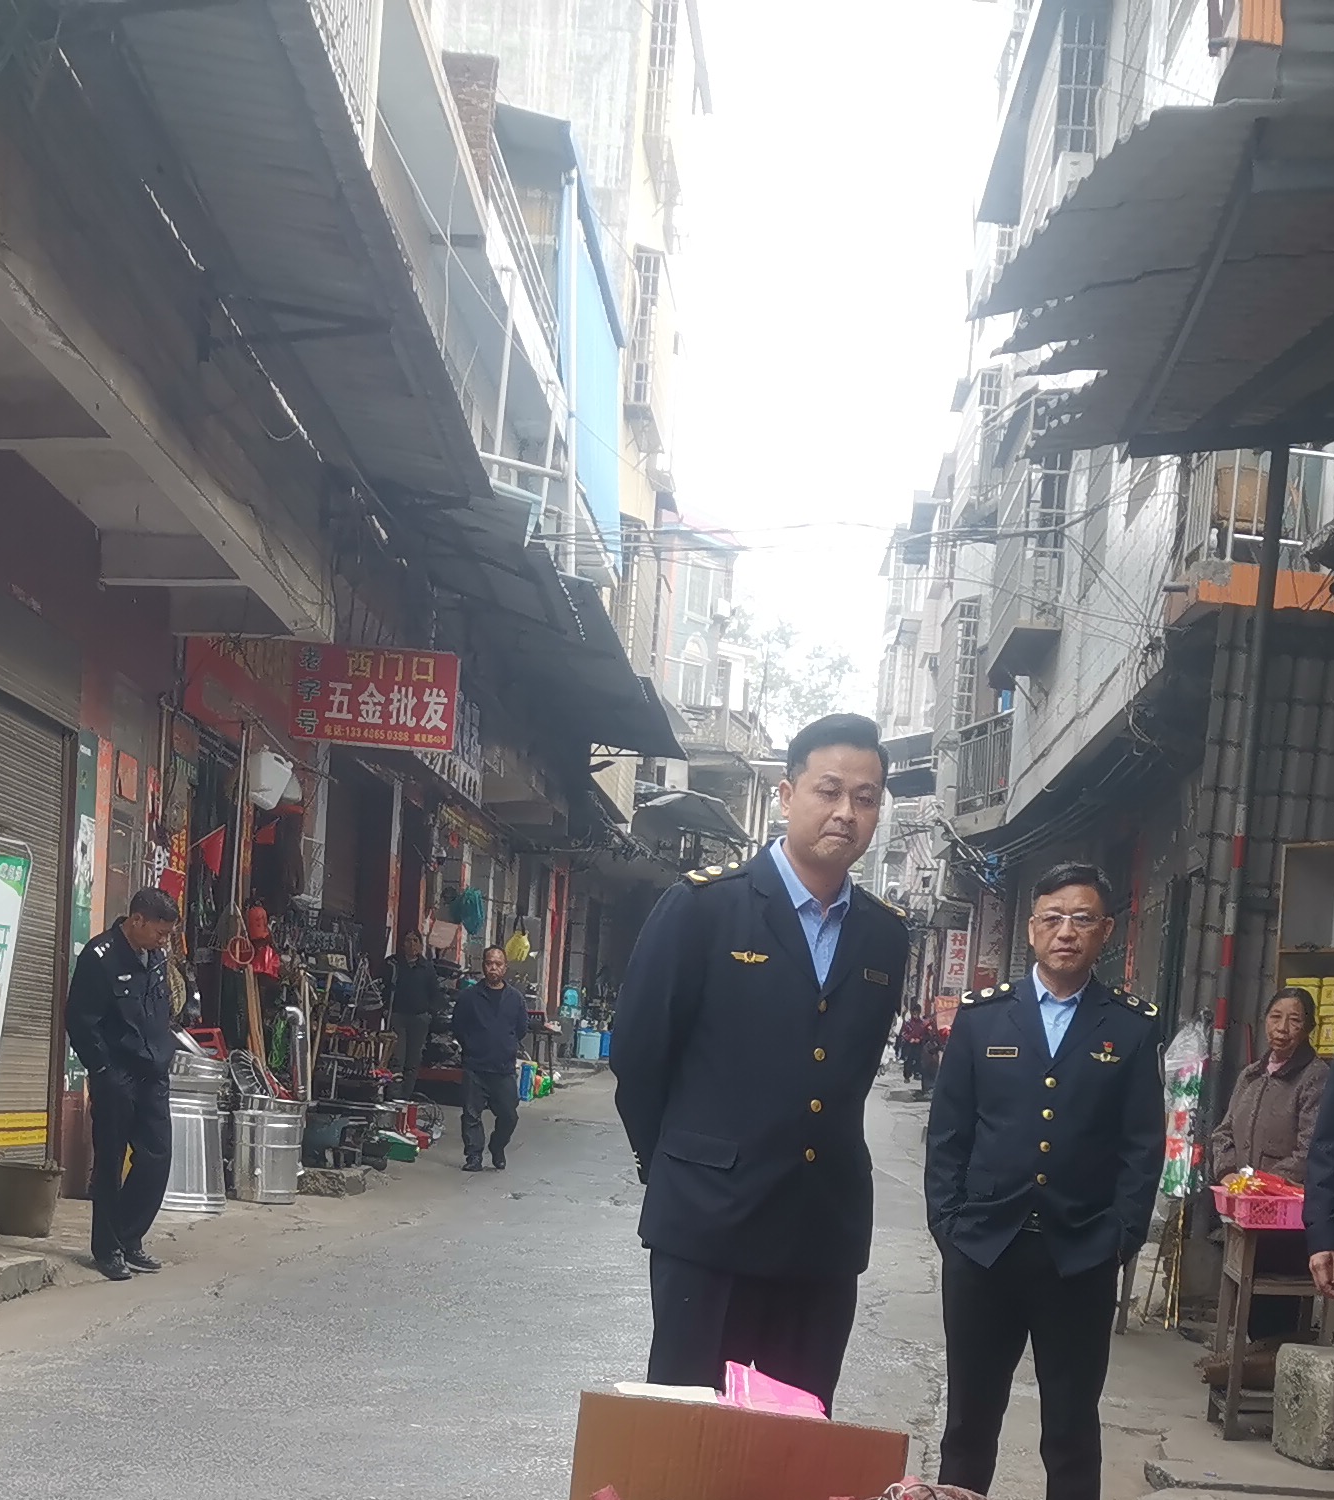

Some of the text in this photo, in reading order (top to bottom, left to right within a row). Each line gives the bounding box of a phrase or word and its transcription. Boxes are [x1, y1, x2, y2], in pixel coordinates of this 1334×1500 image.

[296, 646, 322, 734] 老字号
[346, 650, 435, 683] 西门口
[324, 680, 448, 731] 五金批发
